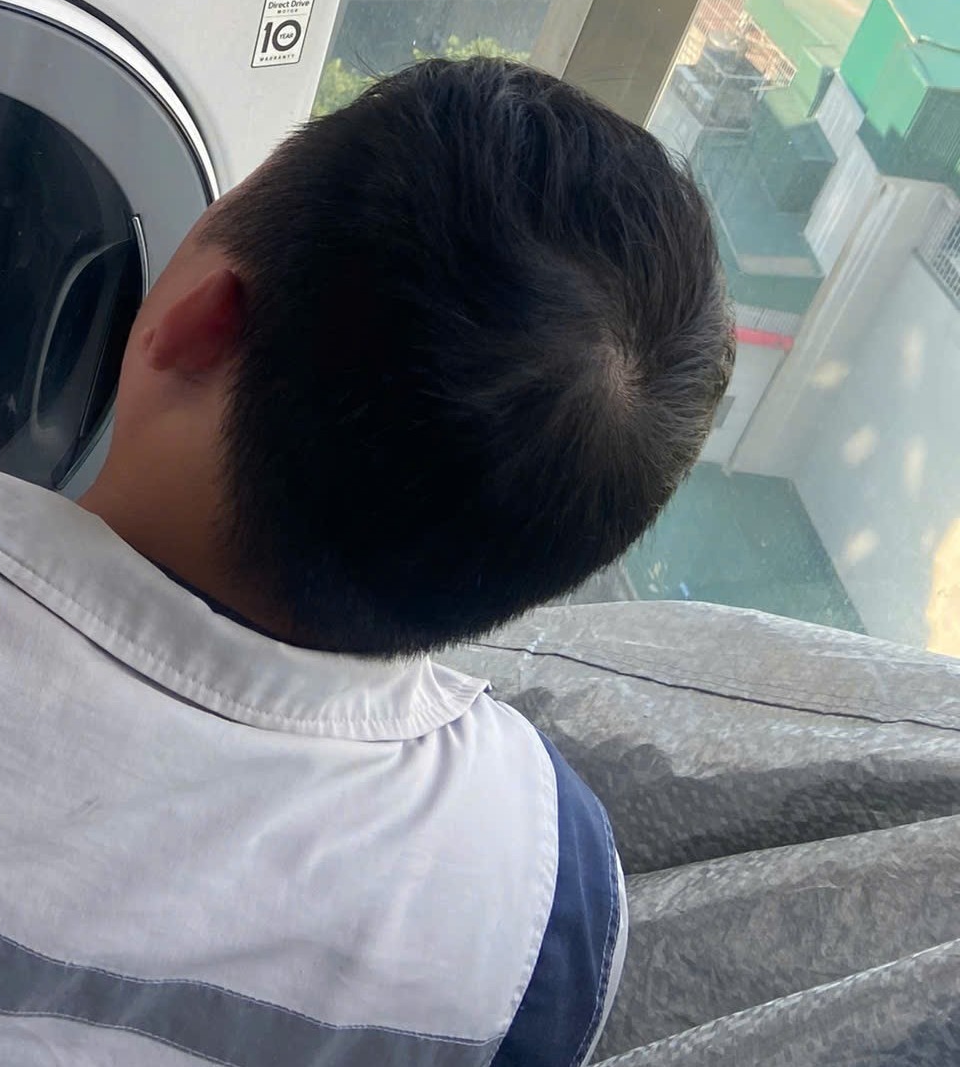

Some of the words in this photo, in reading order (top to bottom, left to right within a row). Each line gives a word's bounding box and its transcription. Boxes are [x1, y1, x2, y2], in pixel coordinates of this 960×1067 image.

[268, 1, 290, 9] Direct
[291, 0, 310, 8] Drive
[261, 20, 301, 53] 10
